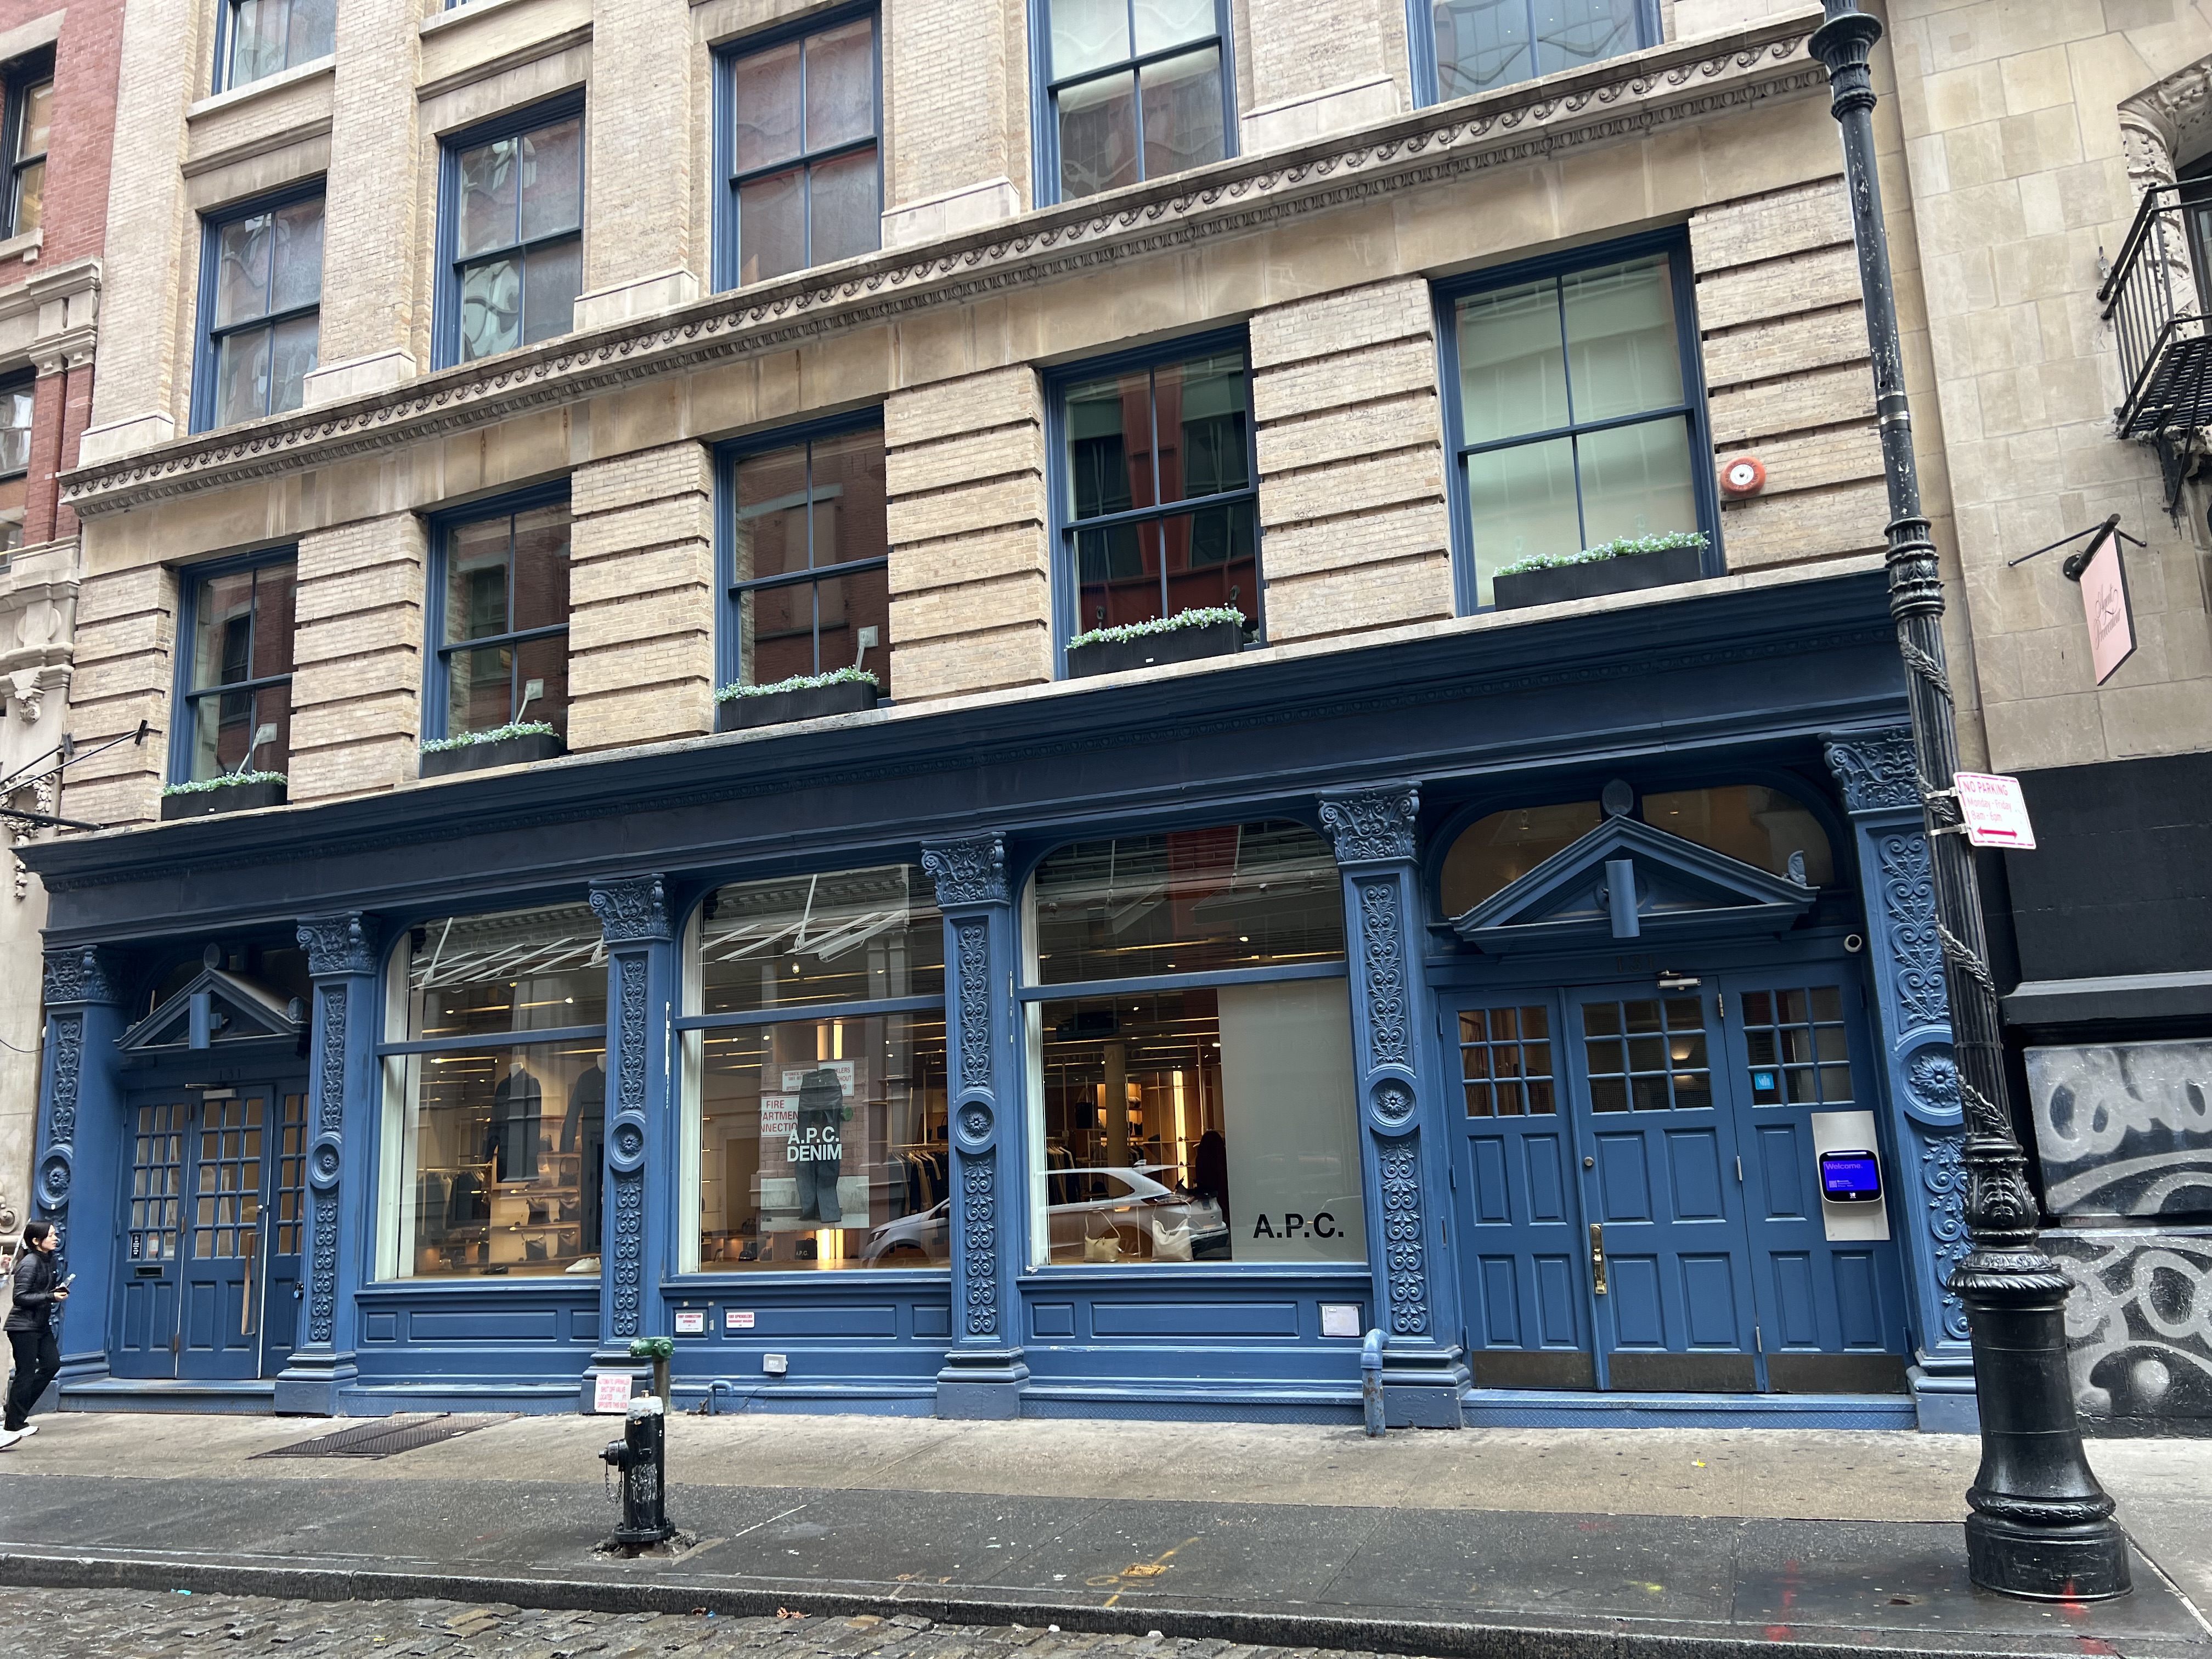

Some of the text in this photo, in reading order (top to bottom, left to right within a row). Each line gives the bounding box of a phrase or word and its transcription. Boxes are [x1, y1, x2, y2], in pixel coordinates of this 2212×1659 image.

[2096, 584, 2118, 625] Agent
[1962, 781, 2008, 795] NO PARKING
[1967, 797, 1991, 810] Monday
[1995, 799, 2012, 812] Friday
[1971, 810, 1985, 820] 8am
[1990, 811, 2003, 823] 6pm
[766, 1100, 785, 1109] FIRE
[763, 1111, 799, 1121] ARTMEN
[762, 1122, 798, 1132] NNECTIO
[788, 1126, 839, 1144] A.P.C.
[787, 1144, 842, 1162] DENIM
[1253, 1212, 1344, 1238] A.P.C.
